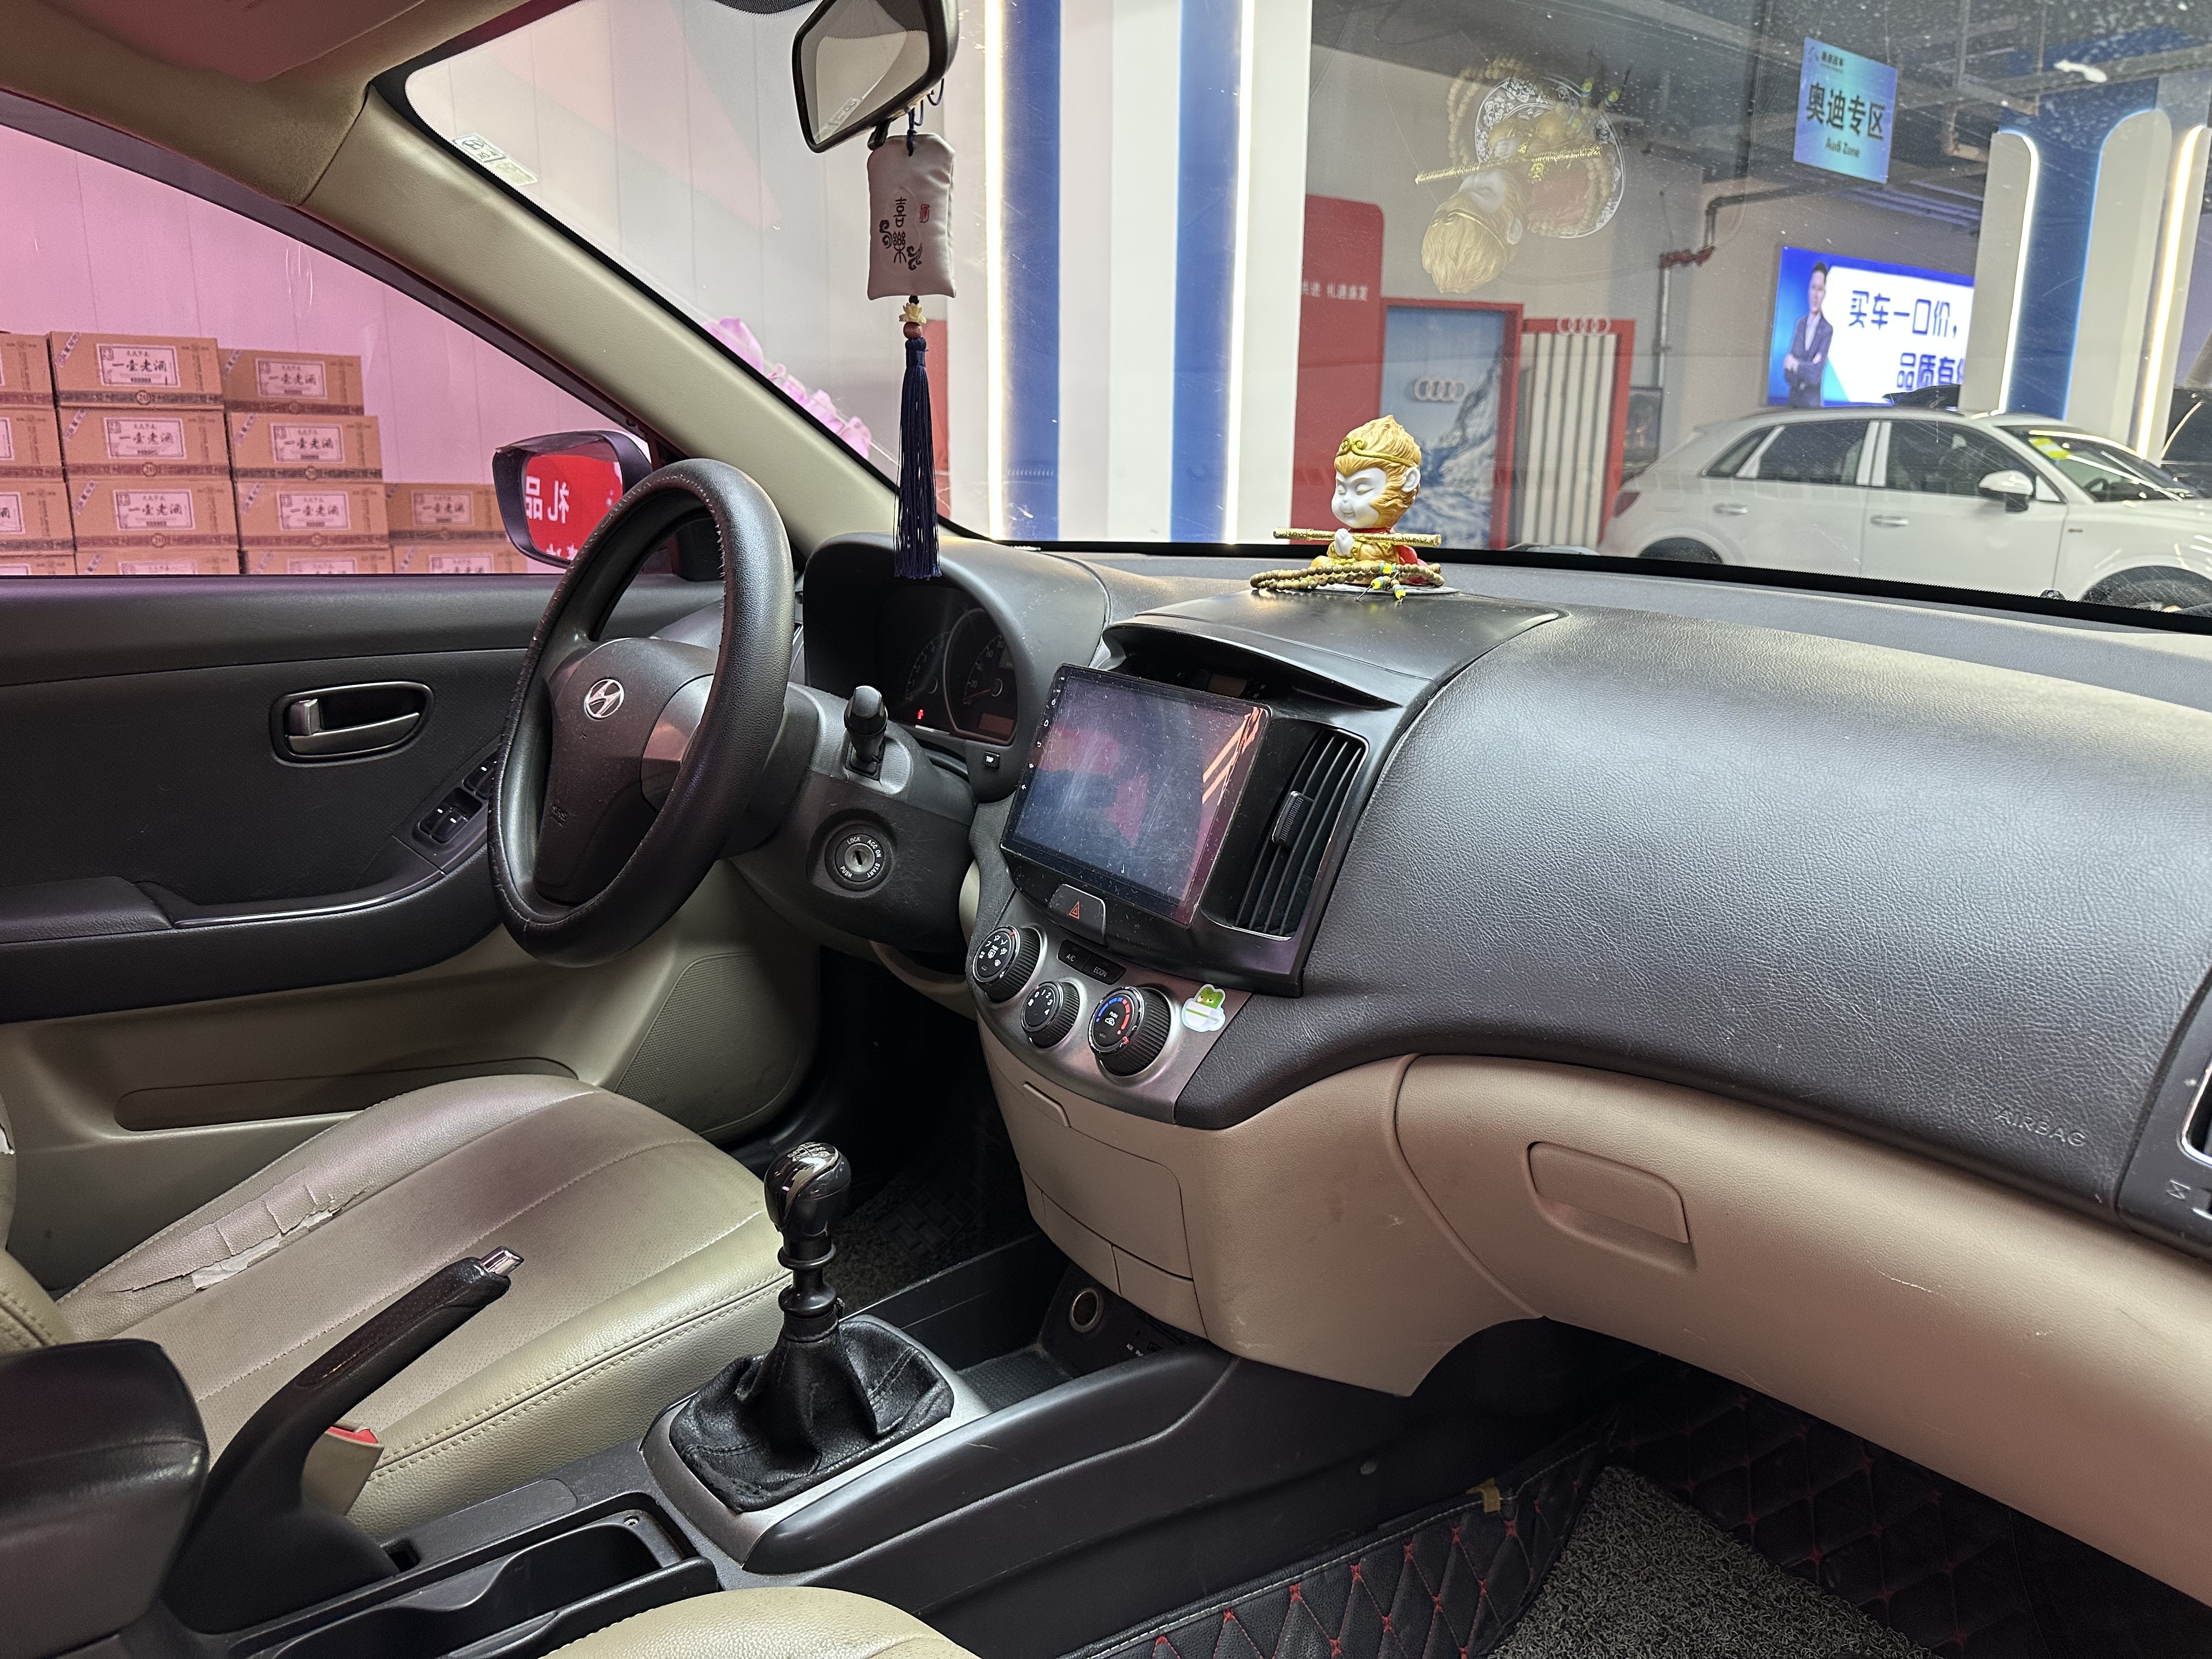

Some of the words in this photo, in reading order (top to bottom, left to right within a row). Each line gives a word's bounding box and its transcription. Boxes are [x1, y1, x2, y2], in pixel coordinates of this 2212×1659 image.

[1806, 82, 1886, 140] 奥迪专区
[1842, 141, 1860, 158] Zone
[847, 836, 861, 845] LOCK
[867, 839, 878, 849] ACC
[875, 849, 882, 857] ON
[840, 865, 853, 878] PUSH
[867, 862, 881, 878] START
[1066, 953, 1076, 962] A/C
[1093, 966, 1108, 978] ECON
[1995, 1109, 2087, 1148] AIRBAG
